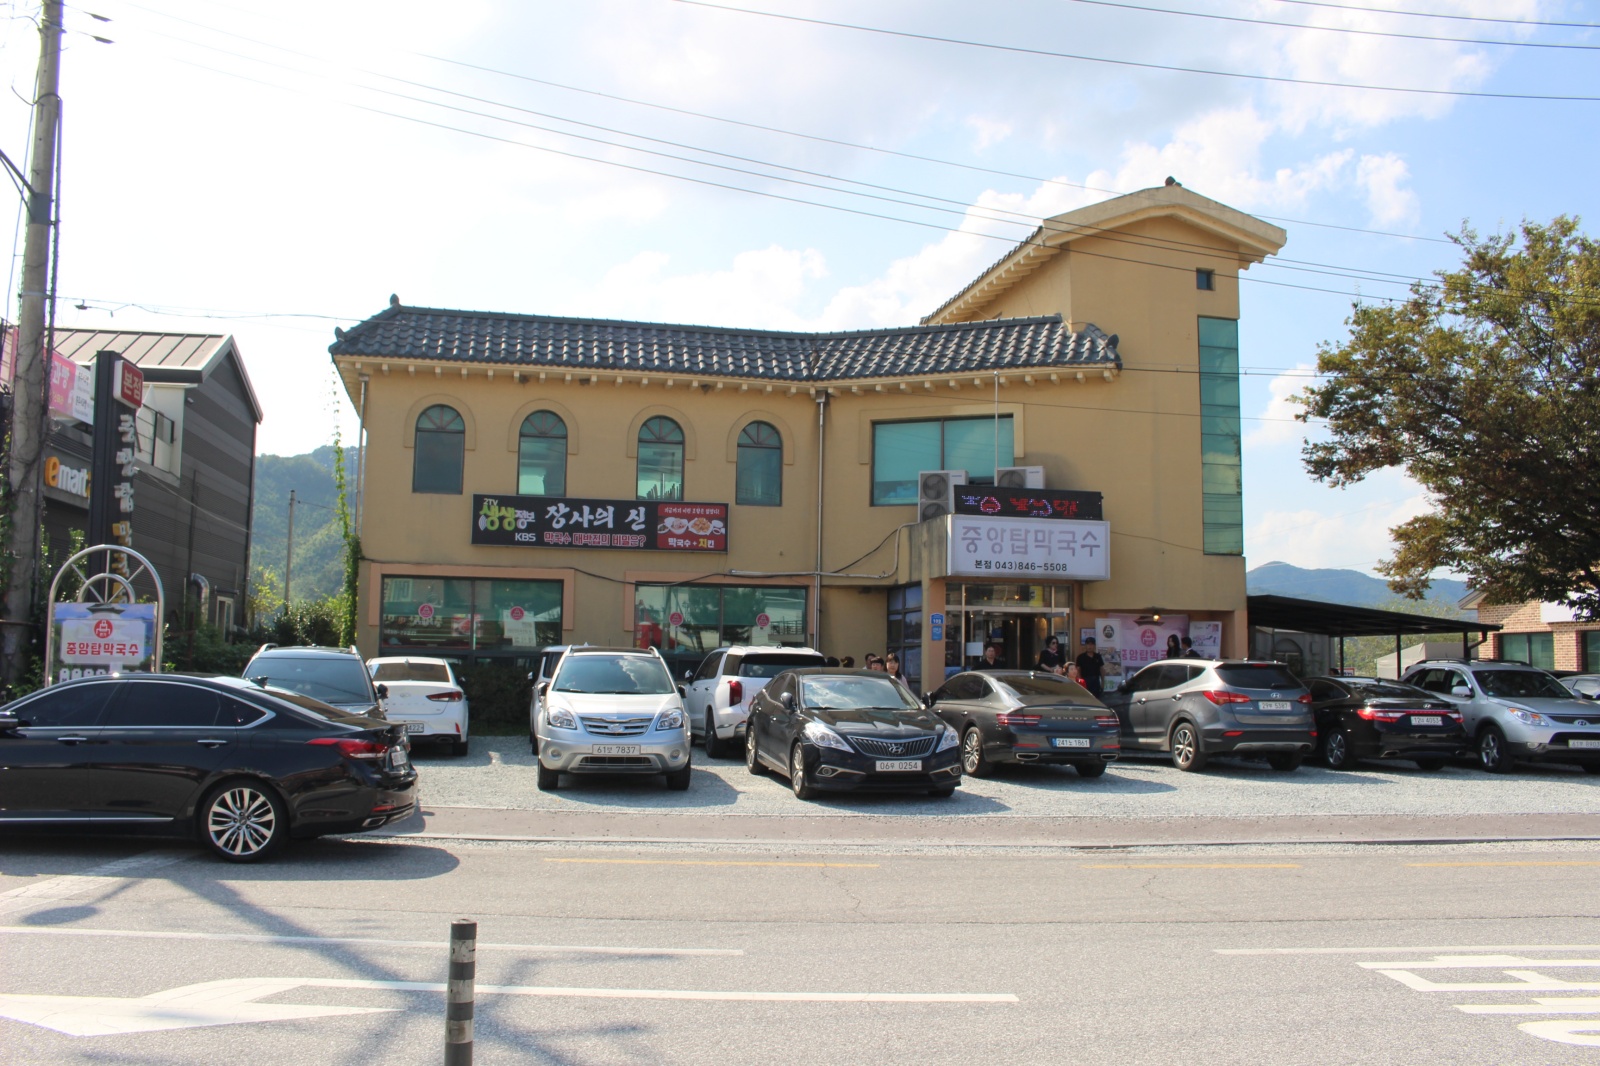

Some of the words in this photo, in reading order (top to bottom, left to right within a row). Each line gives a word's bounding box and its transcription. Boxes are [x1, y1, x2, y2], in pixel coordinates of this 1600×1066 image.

[123, 370, 141, 400] 본점
[44, 456, 92, 501] emart
[483, 498, 498, 506] 2TV
[545, 503, 615, 529] 장사의
[625, 506, 646, 531] 신
[515, 533, 536, 542] KBS
[544, 531, 572, 545] 막국수
[573, 532, 611, 547] 대박집의
[612, 533, 647, 548] 비밀은?
[668, 537, 691, 548] 막국수
[698, 538, 715, 549] 치킨
[961, 526, 1100, 557] 중앙탑막국수
[974, 559, 992, 569] 본점
[995, 560, 1067, 572] 043)846-5508
[67, 642, 140, 656] 중앙탑막국수
[1122, 649, 1168, 661] 중앙탑막국
[616, 746, 636, 754] 7837
[898, 762, 918, 770] 0254
